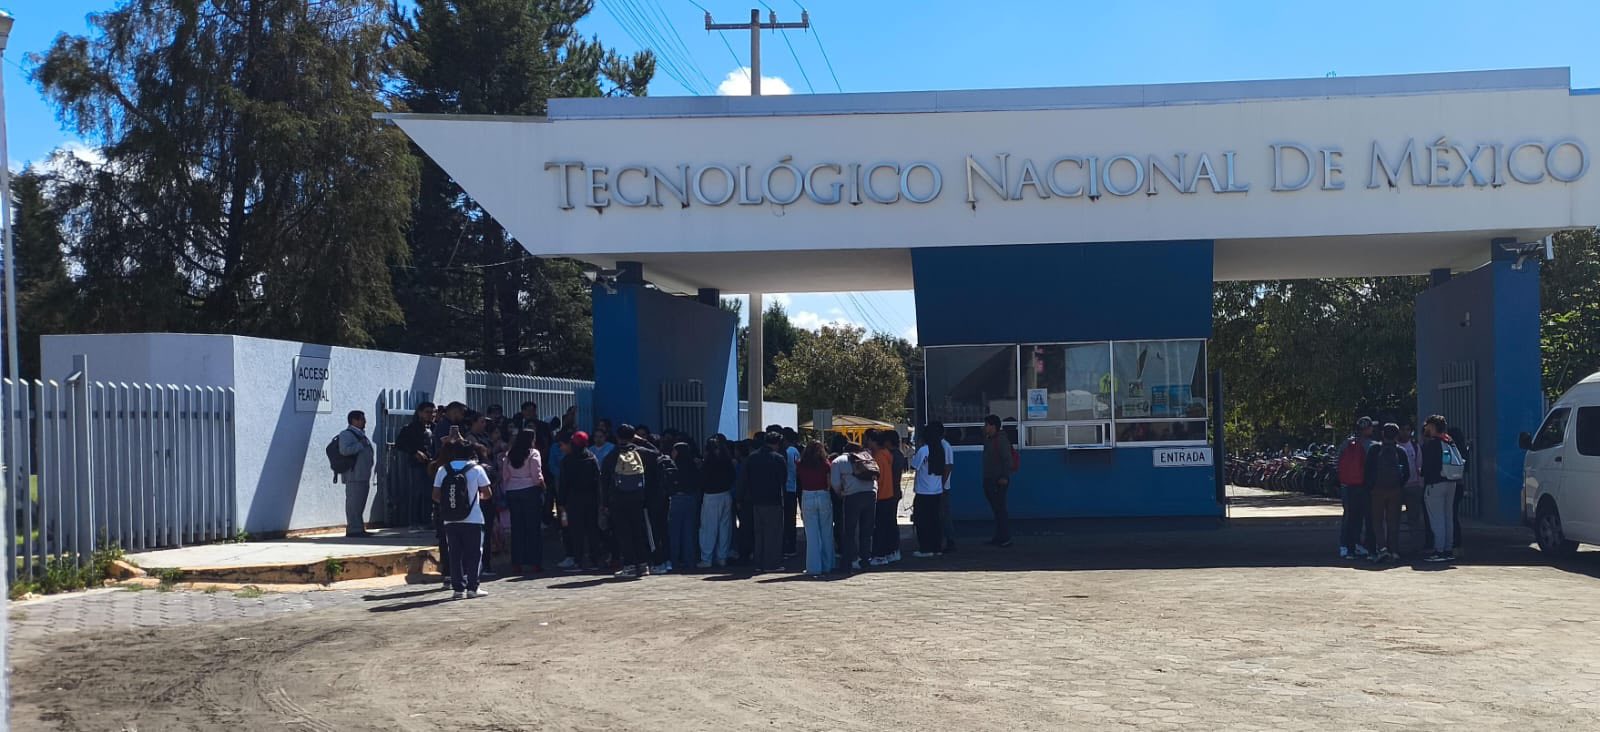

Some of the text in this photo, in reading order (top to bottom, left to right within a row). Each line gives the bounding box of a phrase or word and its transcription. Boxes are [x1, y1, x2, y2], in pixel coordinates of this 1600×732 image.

[543, 136, 1590, 210] TECNOLÓGICO NACIONAL DE MÉXICO
[298, 366, 330, 380] ACCESO
[298, 387, 330, 402] PEATONAL
[1160, 450, 1206, 463] ENTRADA
